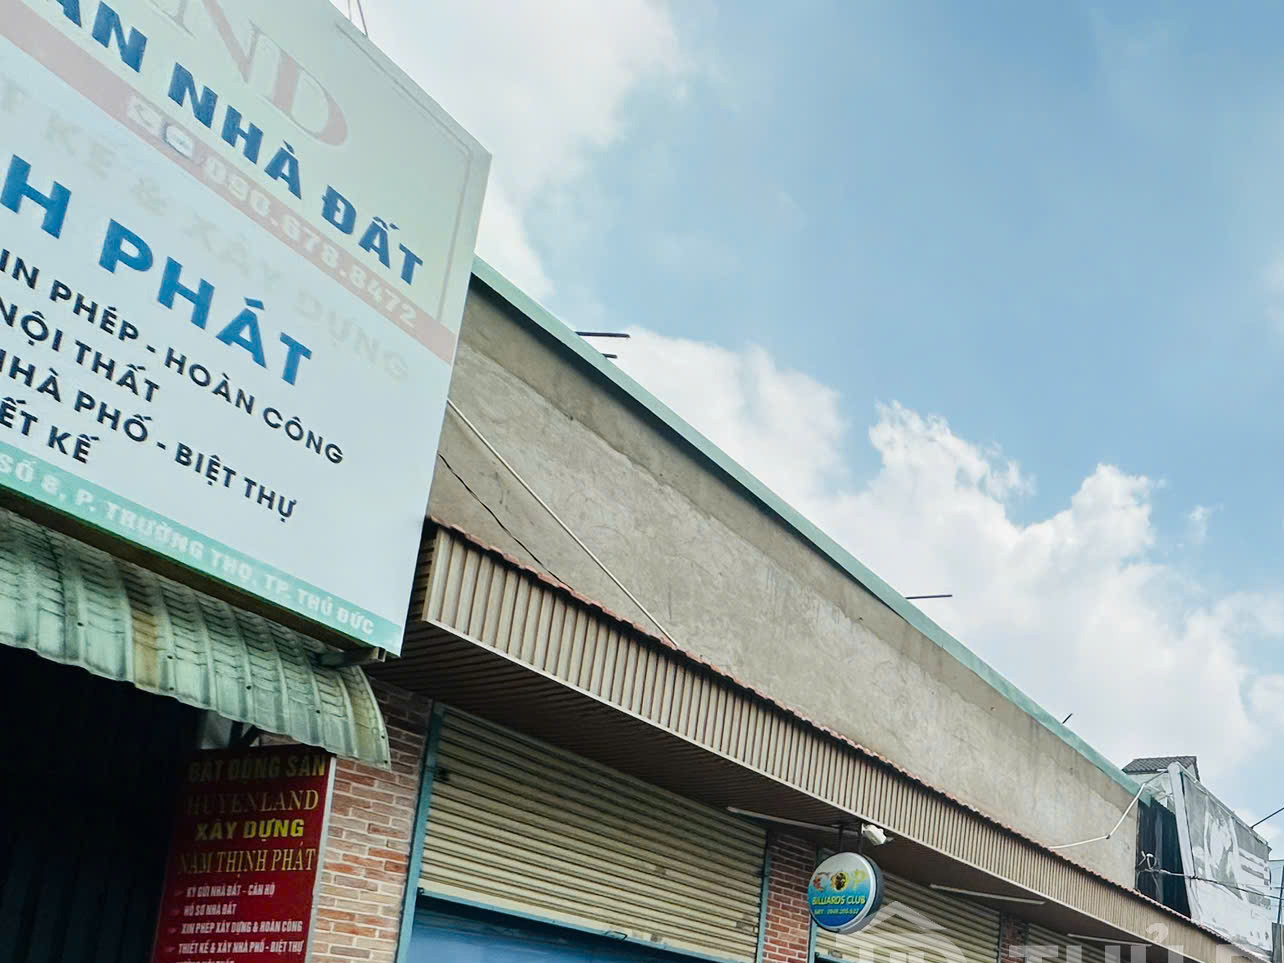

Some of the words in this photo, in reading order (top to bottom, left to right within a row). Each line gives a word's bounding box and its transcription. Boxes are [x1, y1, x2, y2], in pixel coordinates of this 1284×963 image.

[167, 61, 302, 200] NHÀ
[321, 184, 424, 286] ĐẤT
[98, 217, 313, 387] PHÁT
[49, 279, 140, 341] PHÉP
[164, 346, 255, 414] HOÀN
[263, 406, 344, 465] CÔNG
[74, 339, 160, 403] THẤT
[47, 425, 100, 464] KẾ
[73, 389, 152, 443] PHỐ
[175, 442, 236, 488] BIỆT
[243, 476, 298, 522] THỰ
[104, 501, 206, 562] TRƯỜNG
[297, 587, 336, 618] THỦ
[337, 607, 376, 636] ĐỨC
[217, 849, 269, 878] THỊNH
[271, 841, 316, 871] PHÁT
[242, 817, 304, 843] DỰNG
